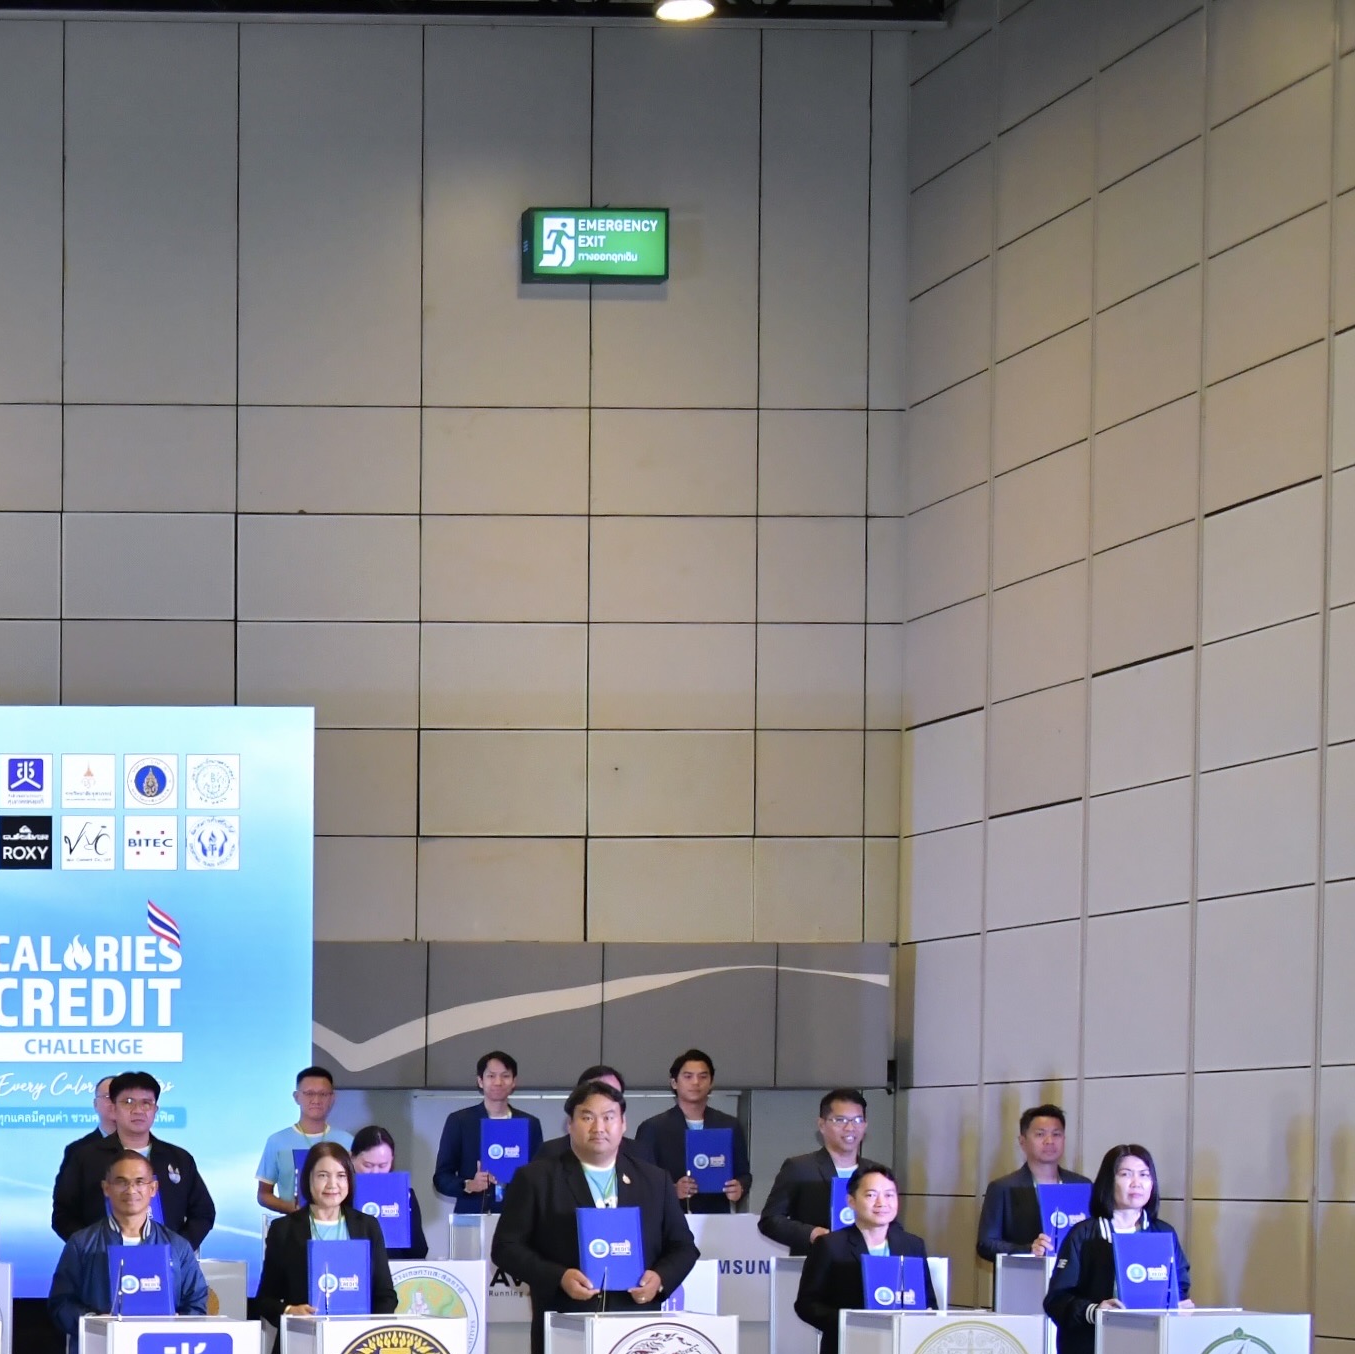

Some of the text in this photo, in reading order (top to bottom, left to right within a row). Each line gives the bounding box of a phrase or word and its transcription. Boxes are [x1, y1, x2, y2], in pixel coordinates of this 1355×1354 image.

[578, 219, 658, 232] EMERGENCY
[578, 235, 606, 248] EXIT
[578, 251, 638, 263] ทางออกฉุกเฉิน
[128, 838, 173, 847] BITEC
[2, 846, 49, 860] ROXY
[24, 1038, 144, 1055] CHALLENGE
[50, 1072, 97, 1097] Calor
[718, 1260, 770, 1274] MSUN
